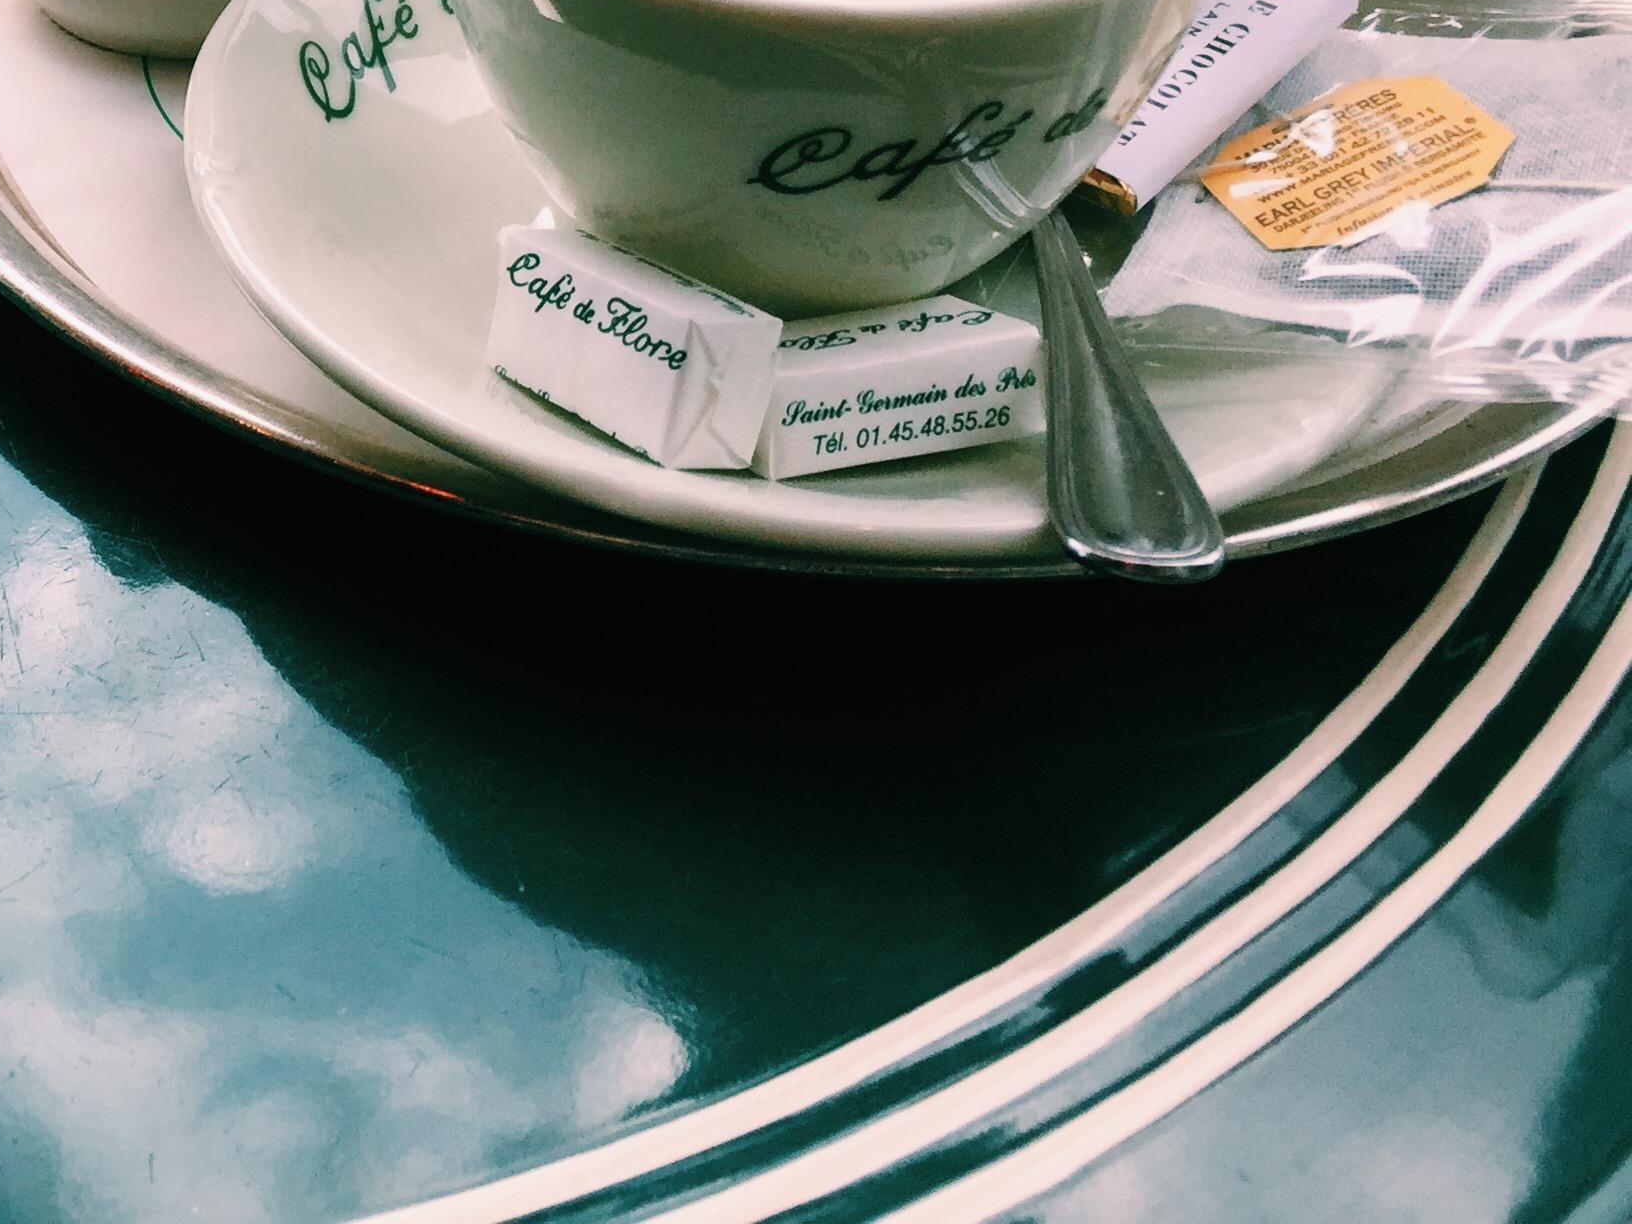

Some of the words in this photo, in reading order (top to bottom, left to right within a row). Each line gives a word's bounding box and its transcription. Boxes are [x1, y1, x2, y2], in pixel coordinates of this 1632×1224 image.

[746, 100, 1033, 202] Café
[1254, 196, 1316, 228] EARL
[1313, 167, 1371, 200] GREY
[507, 253, 576, 313] Café
[573, 299, 596, 325] de
[598, 296, 687, 370] Flore
[954, 373, 987, 399] des
[814, 431, 848, 456] Tél.
[856, 405, 1012, 449] 01.45.48.55.26
